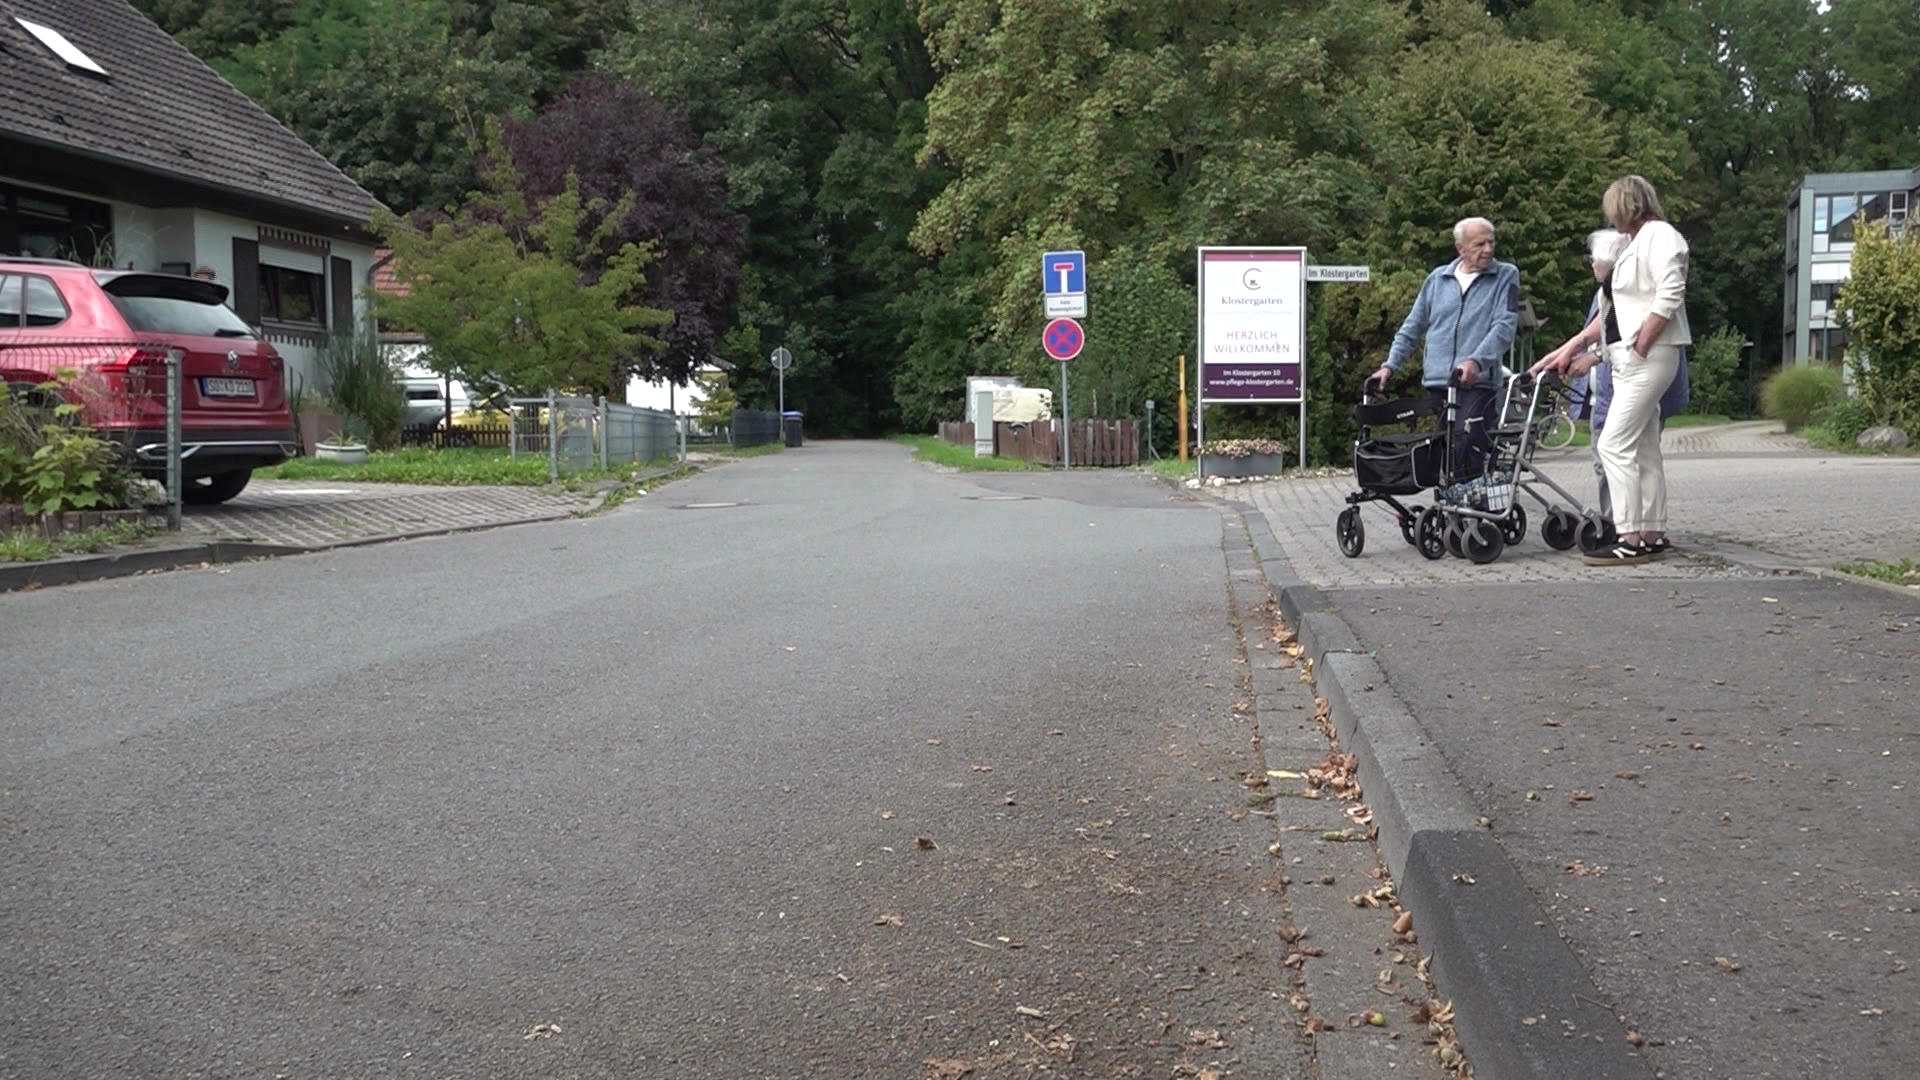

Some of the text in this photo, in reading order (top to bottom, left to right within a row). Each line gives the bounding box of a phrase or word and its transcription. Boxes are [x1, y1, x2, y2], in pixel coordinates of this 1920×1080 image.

[1221, 296, 1283, 307] Klostergarten
[1226, 330, 1278, 340] HERZLICH
[1214, 342, 1290, 354] WILLKOMMEN
[1232, 369, 1272, 377] Klostergarten
[1209, 378, 1294, 387] www.pflege-klostergarten.de
